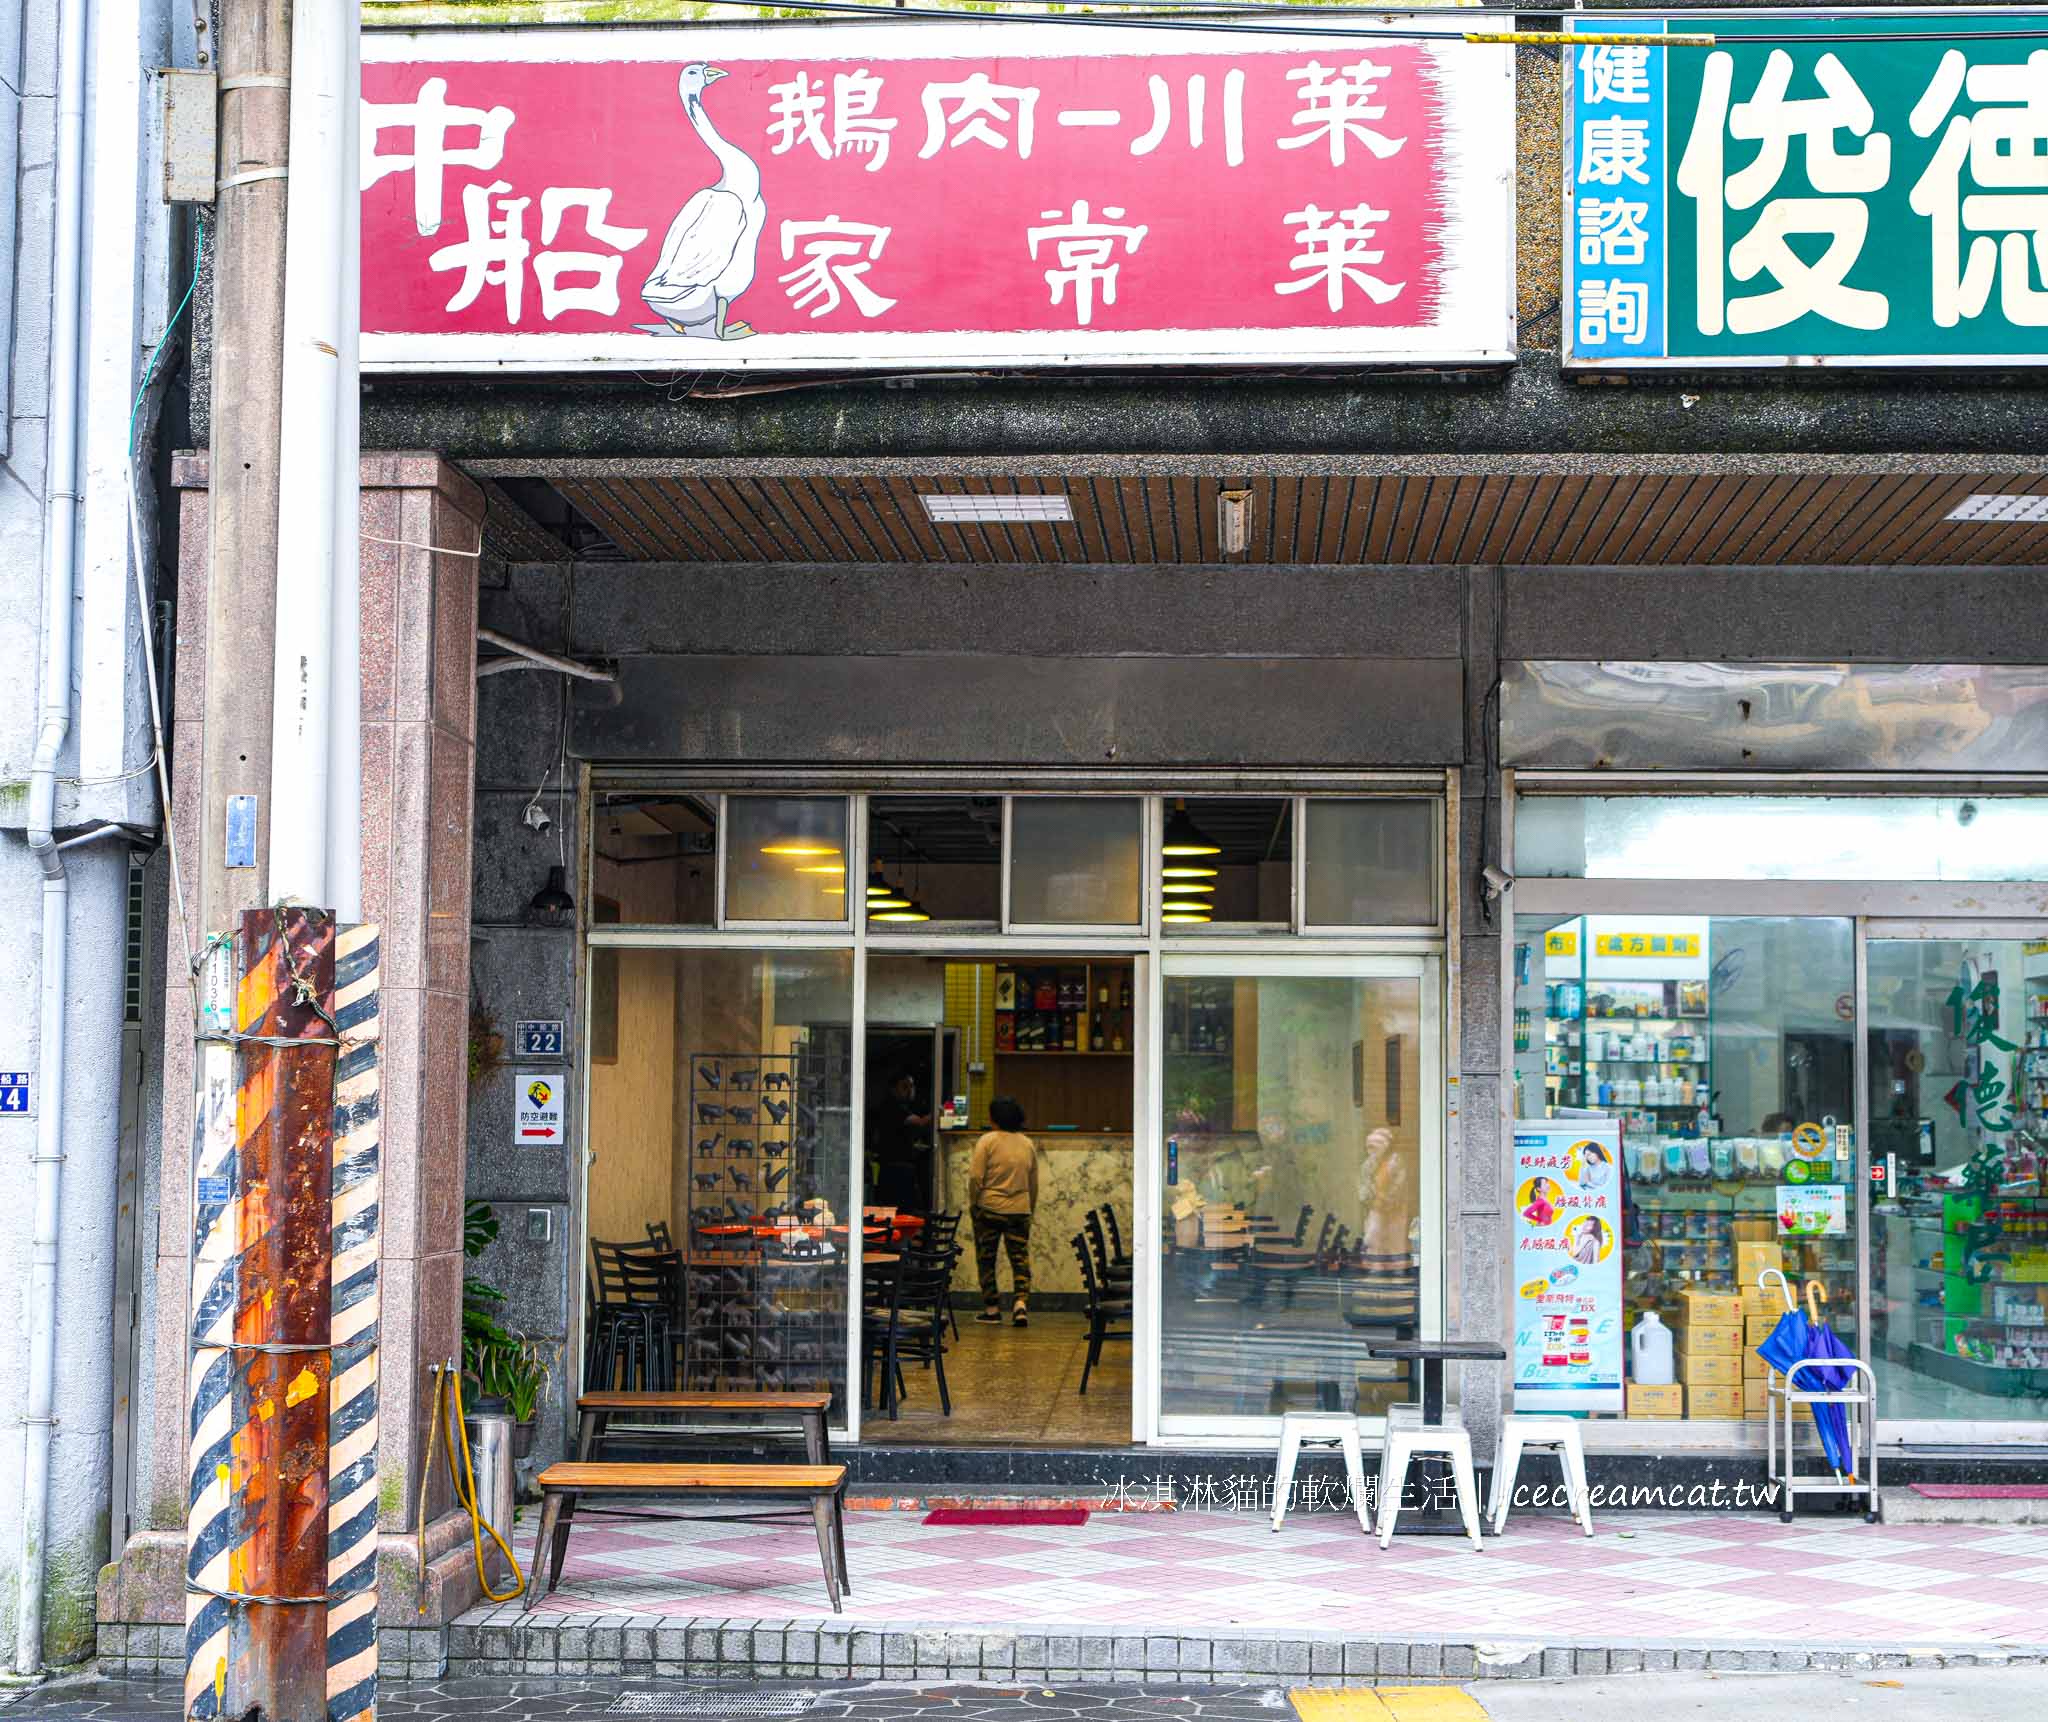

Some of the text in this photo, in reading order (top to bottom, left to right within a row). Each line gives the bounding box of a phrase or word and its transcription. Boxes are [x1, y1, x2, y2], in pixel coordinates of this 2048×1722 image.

[361, 77, 648, 325] 中船
[778, 200, 1406, 326] 家常菜
[1577, 44, 1650, 345] 健康諮詢
[1676, 48, 2048, 335] 俊德
[531, 1033, 556, 1051] 22
[1946, 978, 2018, 1286] 俊德藥局
